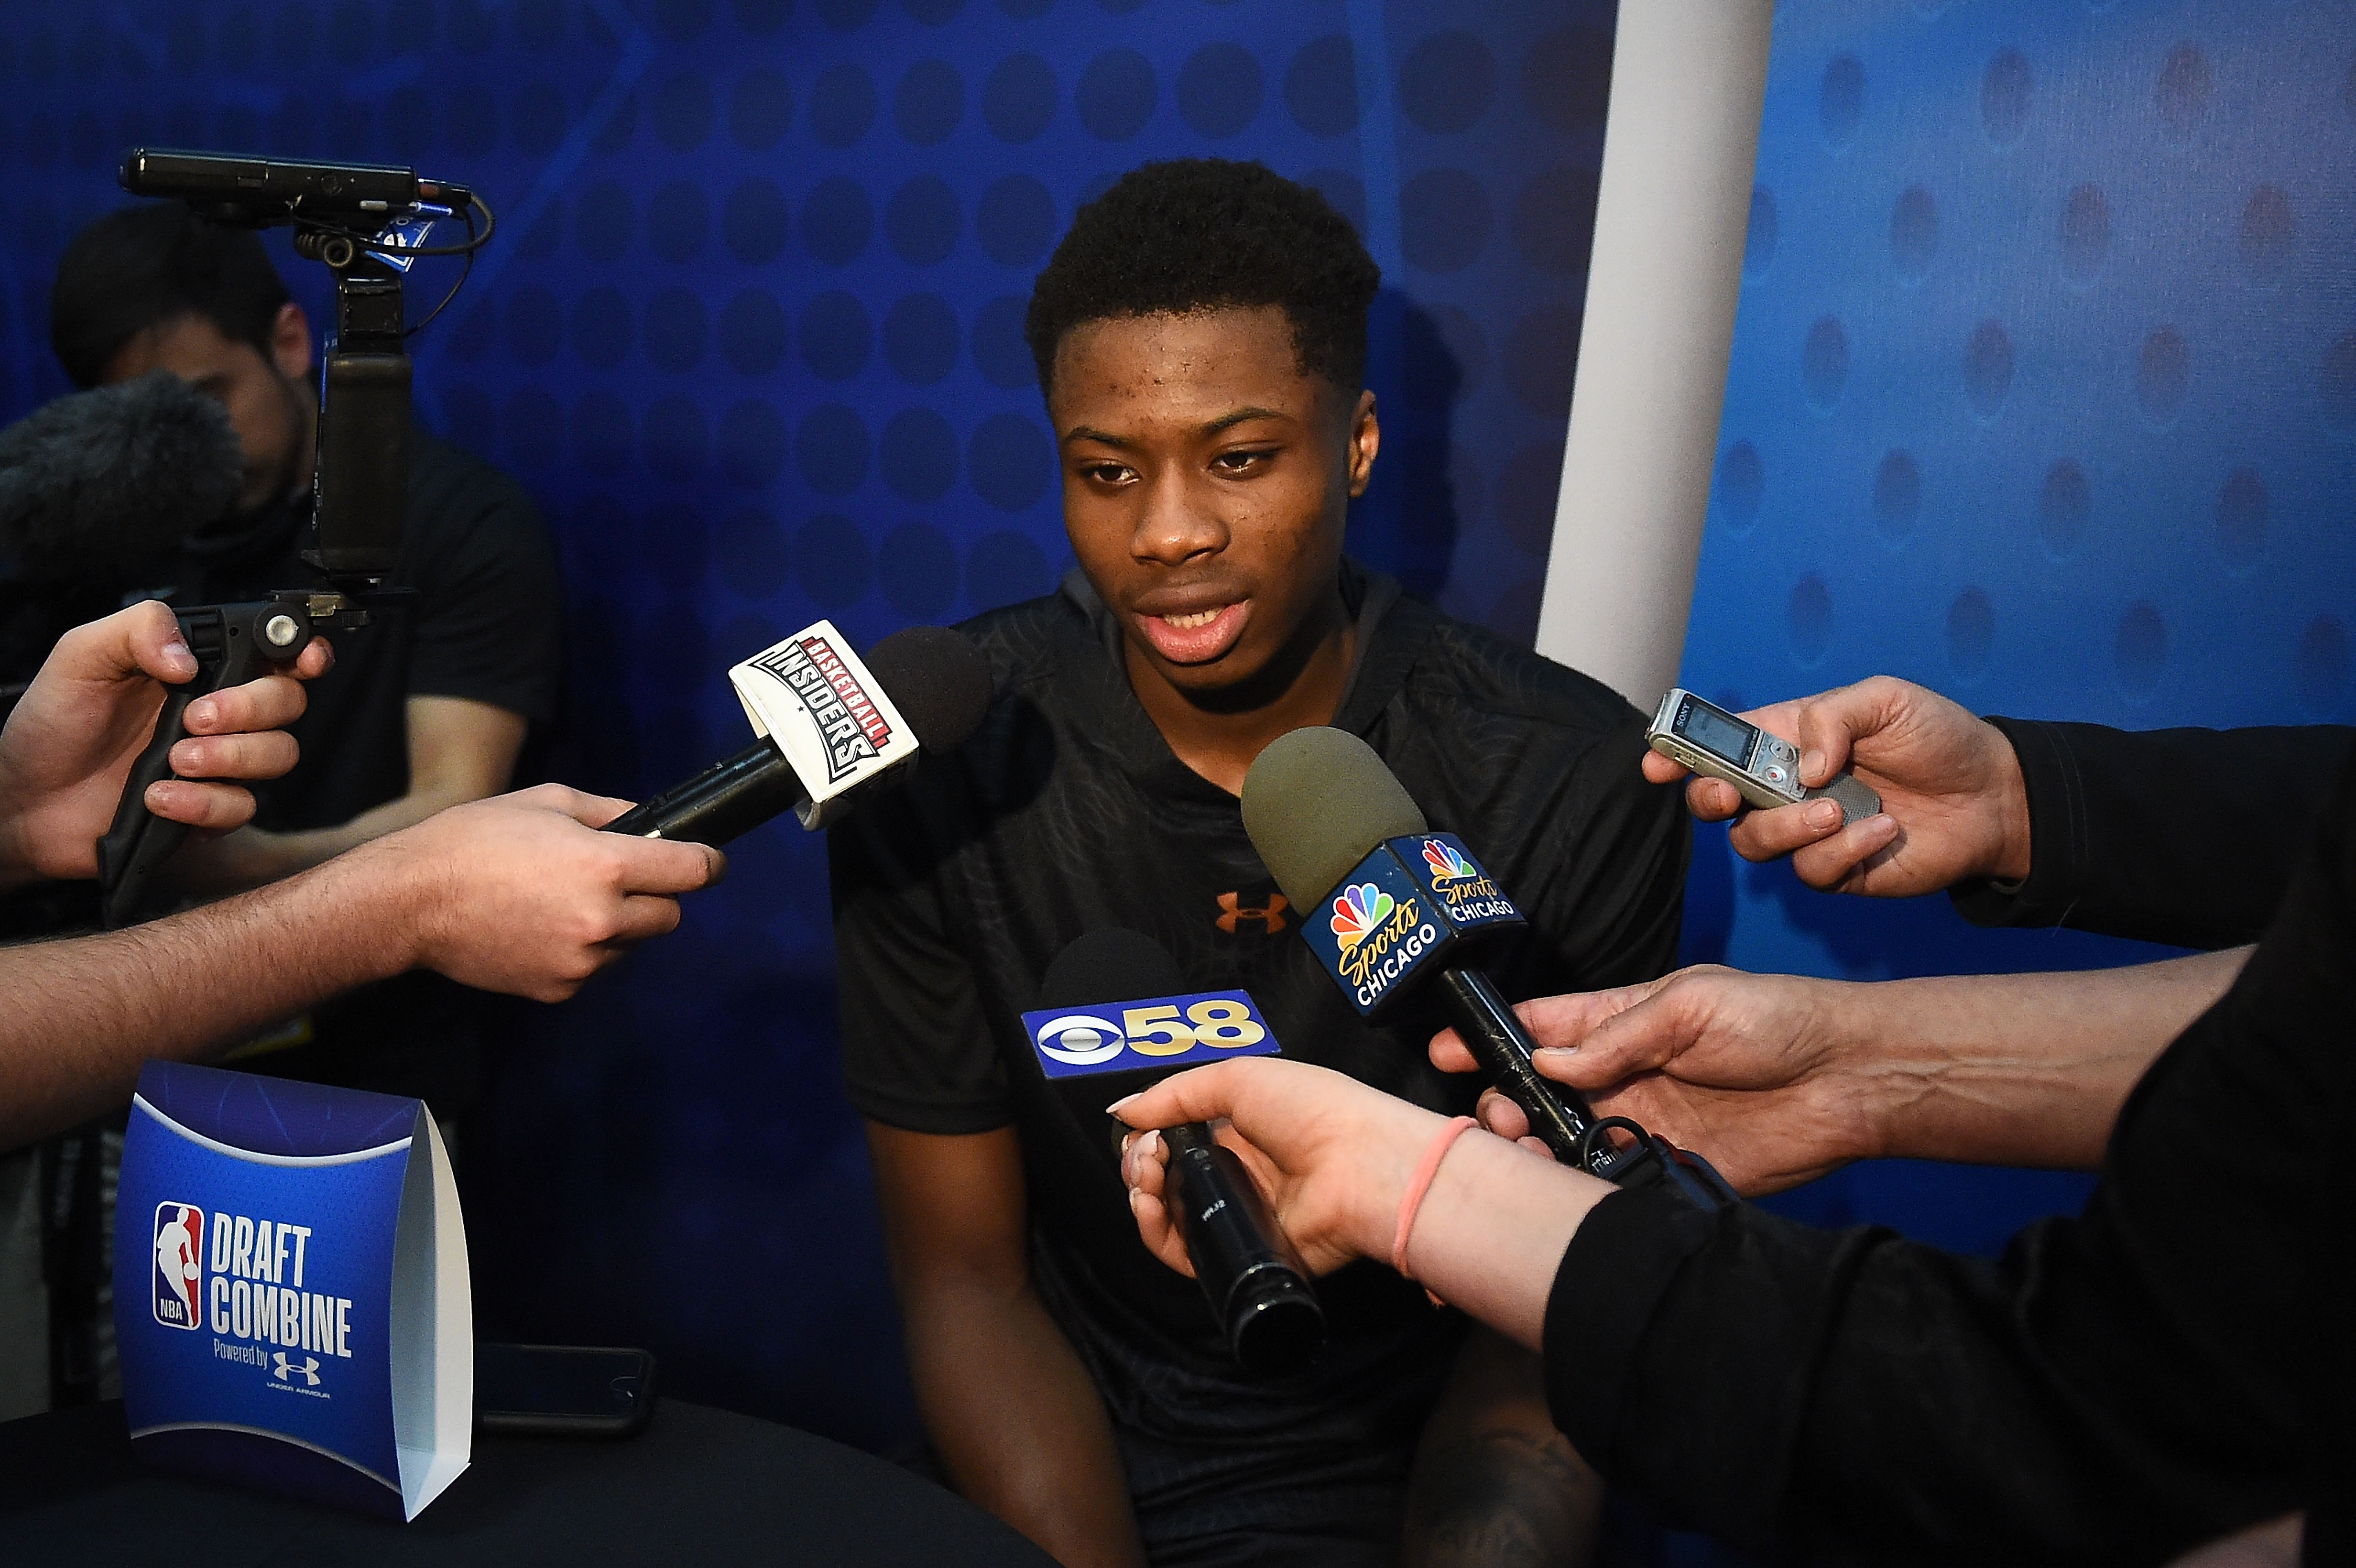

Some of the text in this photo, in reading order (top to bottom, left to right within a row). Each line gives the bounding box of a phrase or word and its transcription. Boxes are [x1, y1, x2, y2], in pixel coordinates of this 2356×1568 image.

[764, 642, 877, 769] INSIDERS
[807, 641, 884, 738] BASKETBALL
[1676, 703, 1691, 727] SONY
[1431, 874, 1498, 905] Sports
[1452, 900, 1515, 922] CHICAGO
[1339, 897, 1419, 987] Sports
[1357, 923, 1436, 1006] CHICAGO
[1123, 999, 1266, 1056] 58
[211, 1212, 312, 1288] DRAFT
[160, 1297, 184, 1322] NBA
[210, 1276, 352, 1359] COMBINE
[213, 1338, 268, 1370] Powered by
[266, 1382, 331, 1399] UNDER ARMOUR
